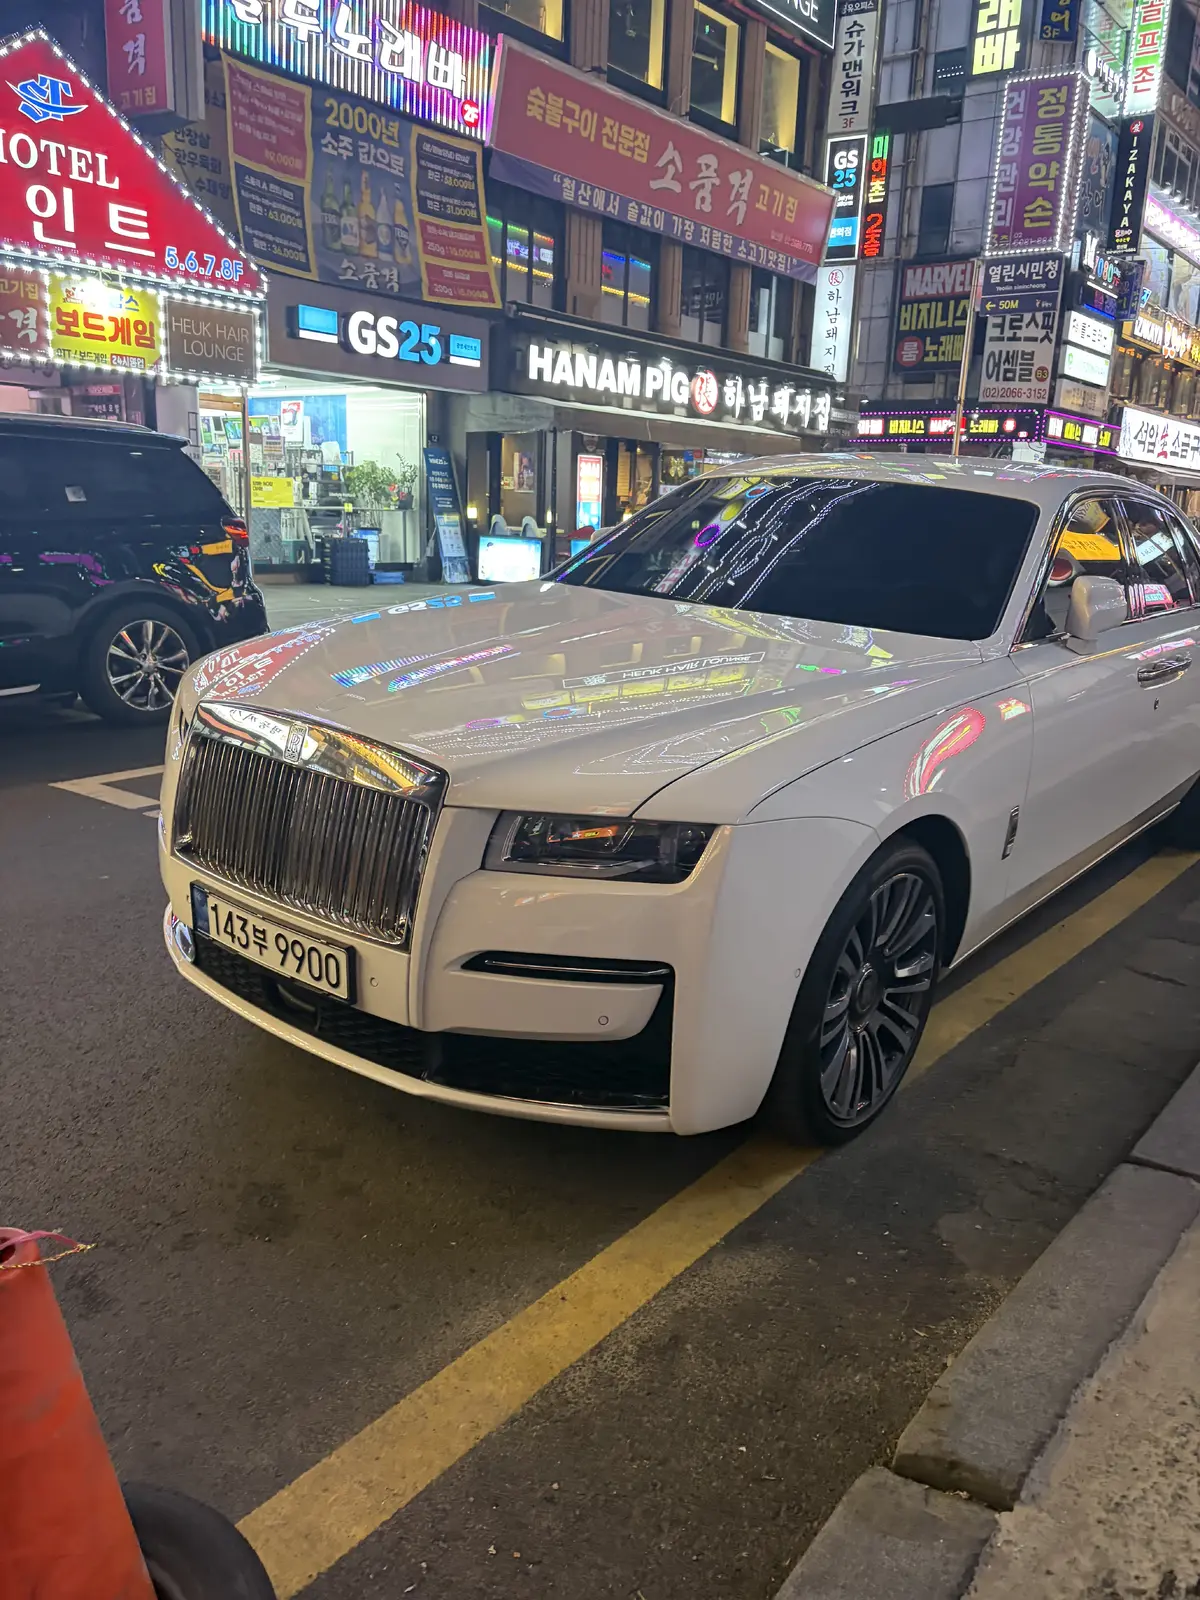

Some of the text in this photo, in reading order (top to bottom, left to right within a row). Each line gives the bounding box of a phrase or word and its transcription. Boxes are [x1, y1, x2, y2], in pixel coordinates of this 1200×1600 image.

[1043, 25, 1061, 38] 3F
[839, 20, 866, 116] 슈가맨워크
[121, 85, 156, 109] 고기집
[325, 98, 400, 148] 2000년
[463, 103, 479, 127] 2F
[842, 118, 855, 129] 3F
[320, 131, 354, 160] 소주
[358, 140, 405, 178] 값으로
[526, 86, 798, 226] 숯불구이 전문점 소풍격 고기집
[833, 150, 859, 170] GS
[832, 168, 857, 189] 25
[1120, 136, 1138, 228] IZAKAYA
[627, 201, 665, 231] 술값이
[672, 216, 695, 241] 가장
[700, 225, 733, 253] 저렴한
[863, 213, 884, 257] 2층
[164, 248, 243, 281] 5.6.7.8F
[999, 300, 1019, 310] 50M
[0, 306, 38, 344] 격
[55, 306, 156, 350] 보드게임
[172, 316, 250, 344] HEUK HAIR
[349, 310, 442, 366] GS25
[183, 338, 245, 363] LOUNGE
[985, 349, 1035, 382] 어셈블
[528, 344, 641, 397] HANAM
[645, 366, 690, 406] PIG
[723, 375, 831, 431] 하남돼지집
[1036, 368, 1048, 380] B3
[982, 386, 1047, 400] (02)2066-3152
[210, 903, 341, 990] 143부 9900
